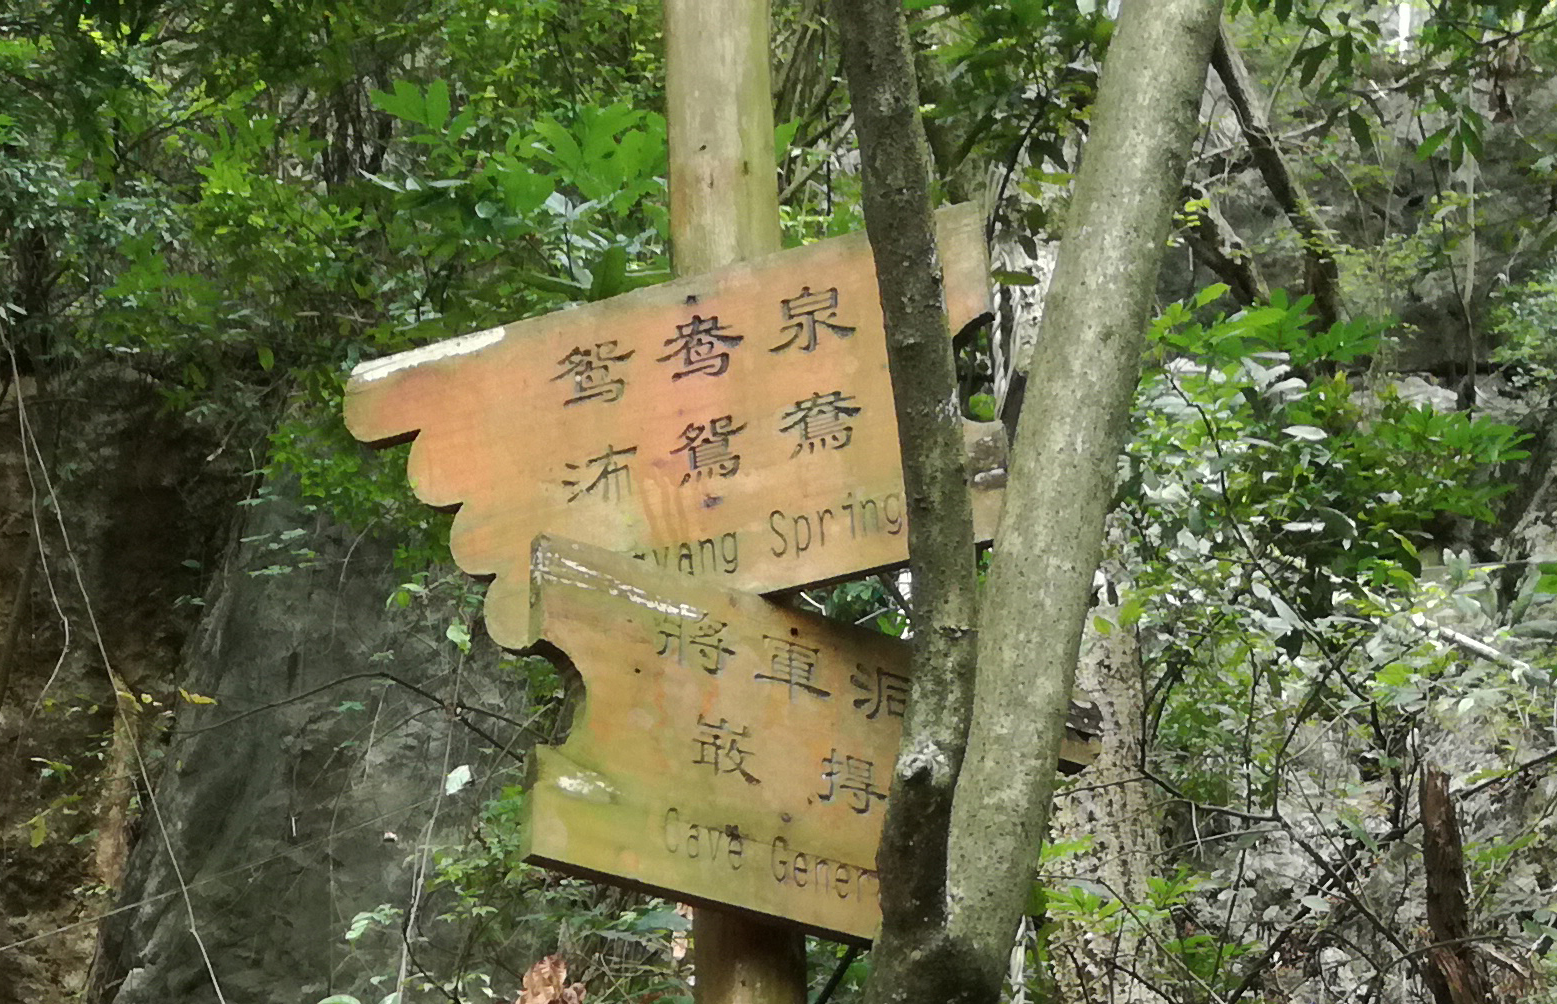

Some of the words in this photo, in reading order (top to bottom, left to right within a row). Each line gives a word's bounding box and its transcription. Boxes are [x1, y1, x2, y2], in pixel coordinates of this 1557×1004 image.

[549, 286, 857, 408] 鸳鸯泉
[769, 491, 904, 559] Spring
[664, 807, 744, 870] Cave
[771, 835, 880, 903] Gener
